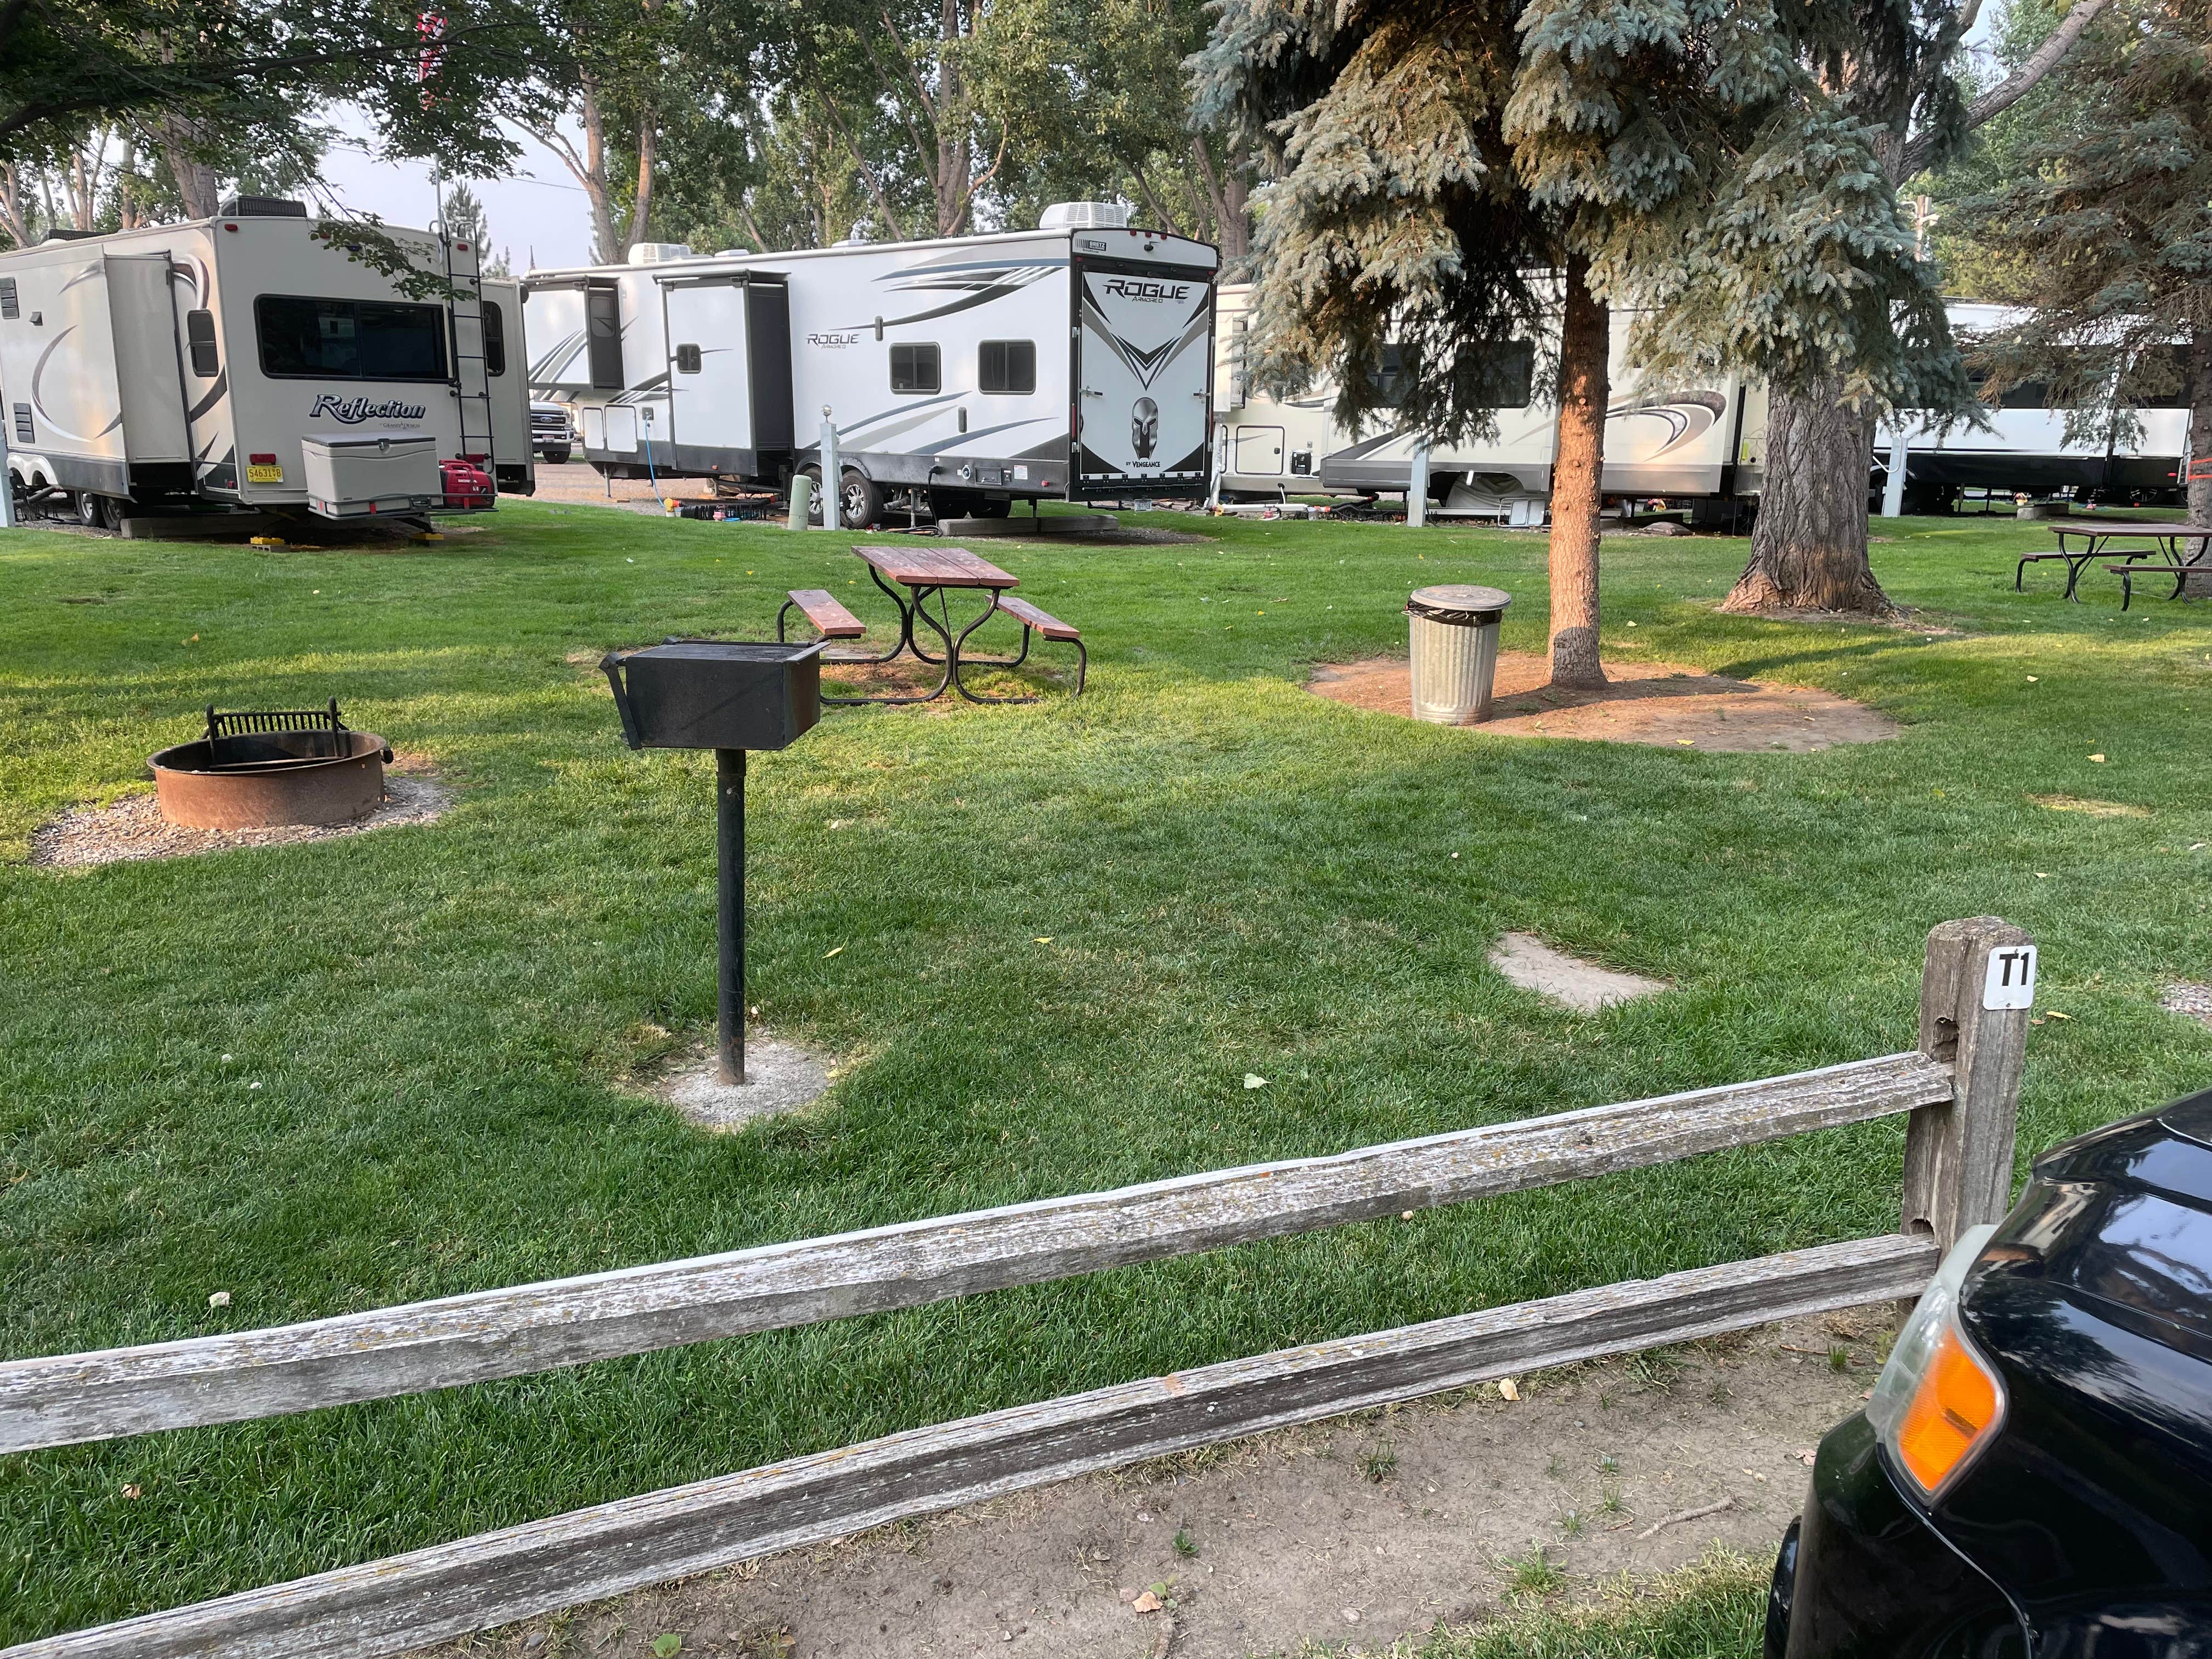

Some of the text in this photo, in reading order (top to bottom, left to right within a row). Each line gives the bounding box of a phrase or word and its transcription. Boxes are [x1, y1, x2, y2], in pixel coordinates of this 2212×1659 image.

[1102, 279, 1190, 300] ROGUE
[805, 334, 860, 347] ROGUE
[309, 394, 426, 424] Reflection
[1999, 952, 2030, 986] T1
